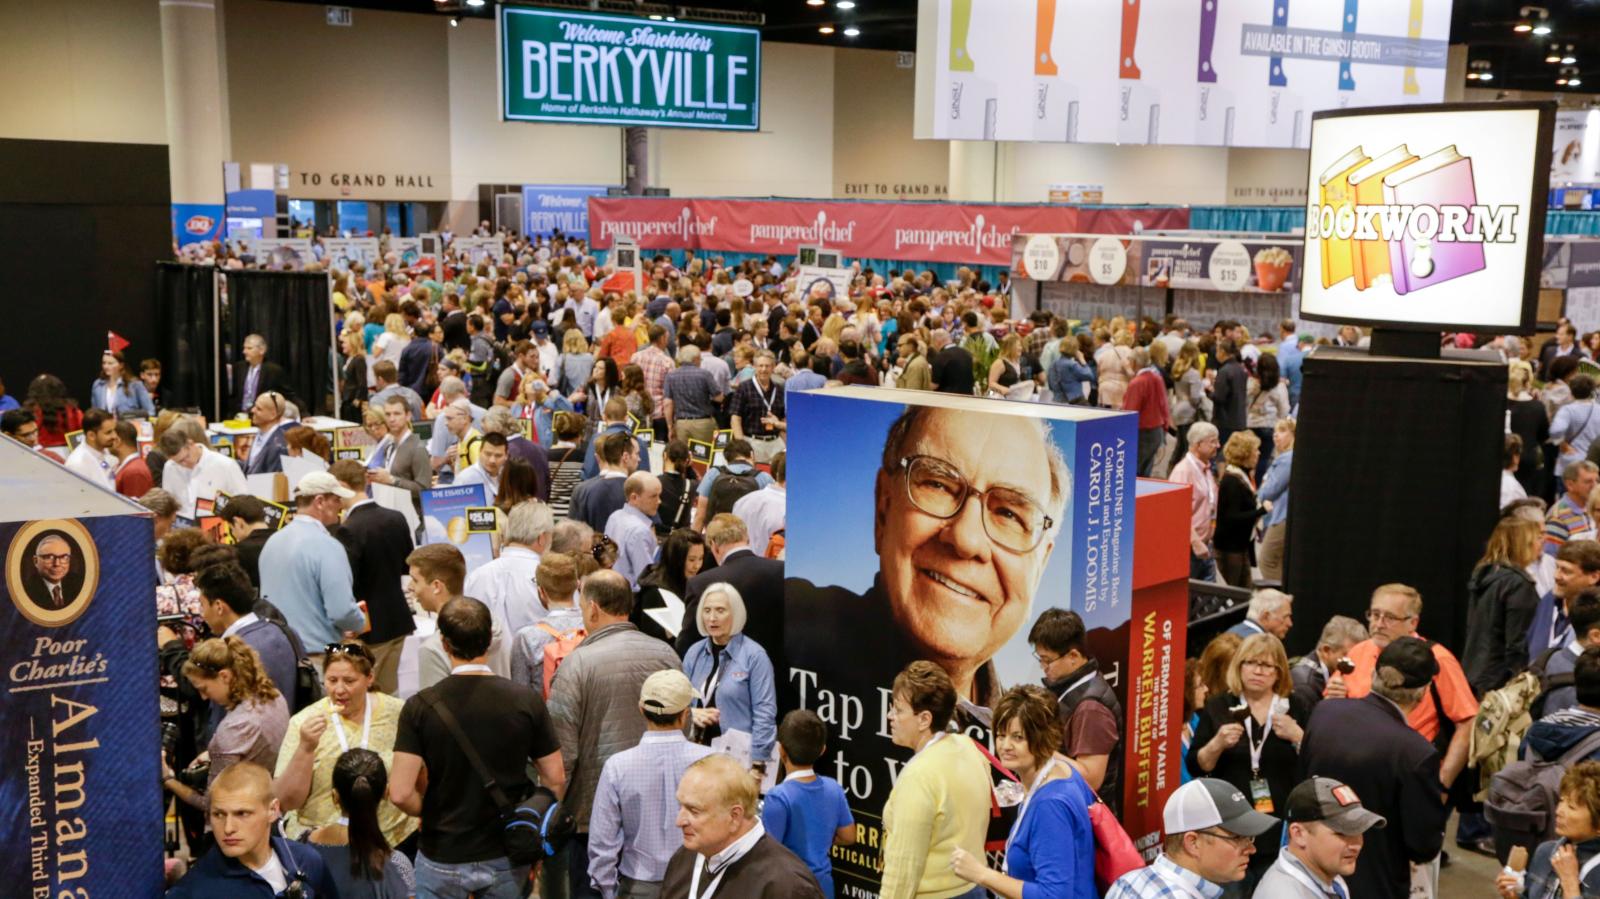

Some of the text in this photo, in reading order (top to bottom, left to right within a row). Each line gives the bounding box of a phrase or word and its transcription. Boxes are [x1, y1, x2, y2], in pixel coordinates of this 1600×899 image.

[559, 21, 713, 51] Welcome Shareholders
[1244, 32, 1292, 53] AVAILABLE
[1293, 35, 1303, 53] IN
[1304, 36, 1322, 55] THE
[1322, 37, 1351, 57] GINSU
[1352, 39, 1381, 60] BOOTH
[522, 40, 748, 110] BERKYVILLE
[541, 102, 727, 123] Home of Berkshire Hathaway's Annual Meeting
[951, 82, 962, 120] GINSU
[1037, 83, 1047, 120] GINSU
[301, 173, 434, 188] TO GRAND HALL
[845, 183, 868, 194] EXIT
[875, 183, 887, 194] TO
[893, 184, 929, 195] GRAND
[531, 211, 587, 233] BERKYVILLE
[600, 216, 718, 240] pampered chef
[751, 220, 856, 245] pampered chef
[1309, 203, 1519, 243] BOOKWORM
[895, 224, 974, 251] pampered
[1034, 259, 1048, 270] $10
[1102, 263, 1112, 275] $5
[1221, 269, 1237, 281] $15
[431, 491, 444, 499] THE
[465, 487, 474, 495] OF
[1085, 442, 1102, 613] CAROL J. LOOMIS
[1099, 447, 1114, 602] Collected and Expanded by
[1111, 437, 1126, 608] A FORTUNE Magazine Book
[31, 636, 87, 657] Poor
[9, 653, 108, 683] Charlie's
[790, 667, 864, 741] Tap
[1137, 611, 1156, 808] WARREN BUFFETT
[1156, 619, 1172, 790] OF PERMANENT VALUE
[1151, 727, 1158, 740] OF
[833, 750, 873, 799] to
[30, 831, 49, 881] Third
[829, 844, 885, 872] CTICALL
[842, 883, 849, 896] A
